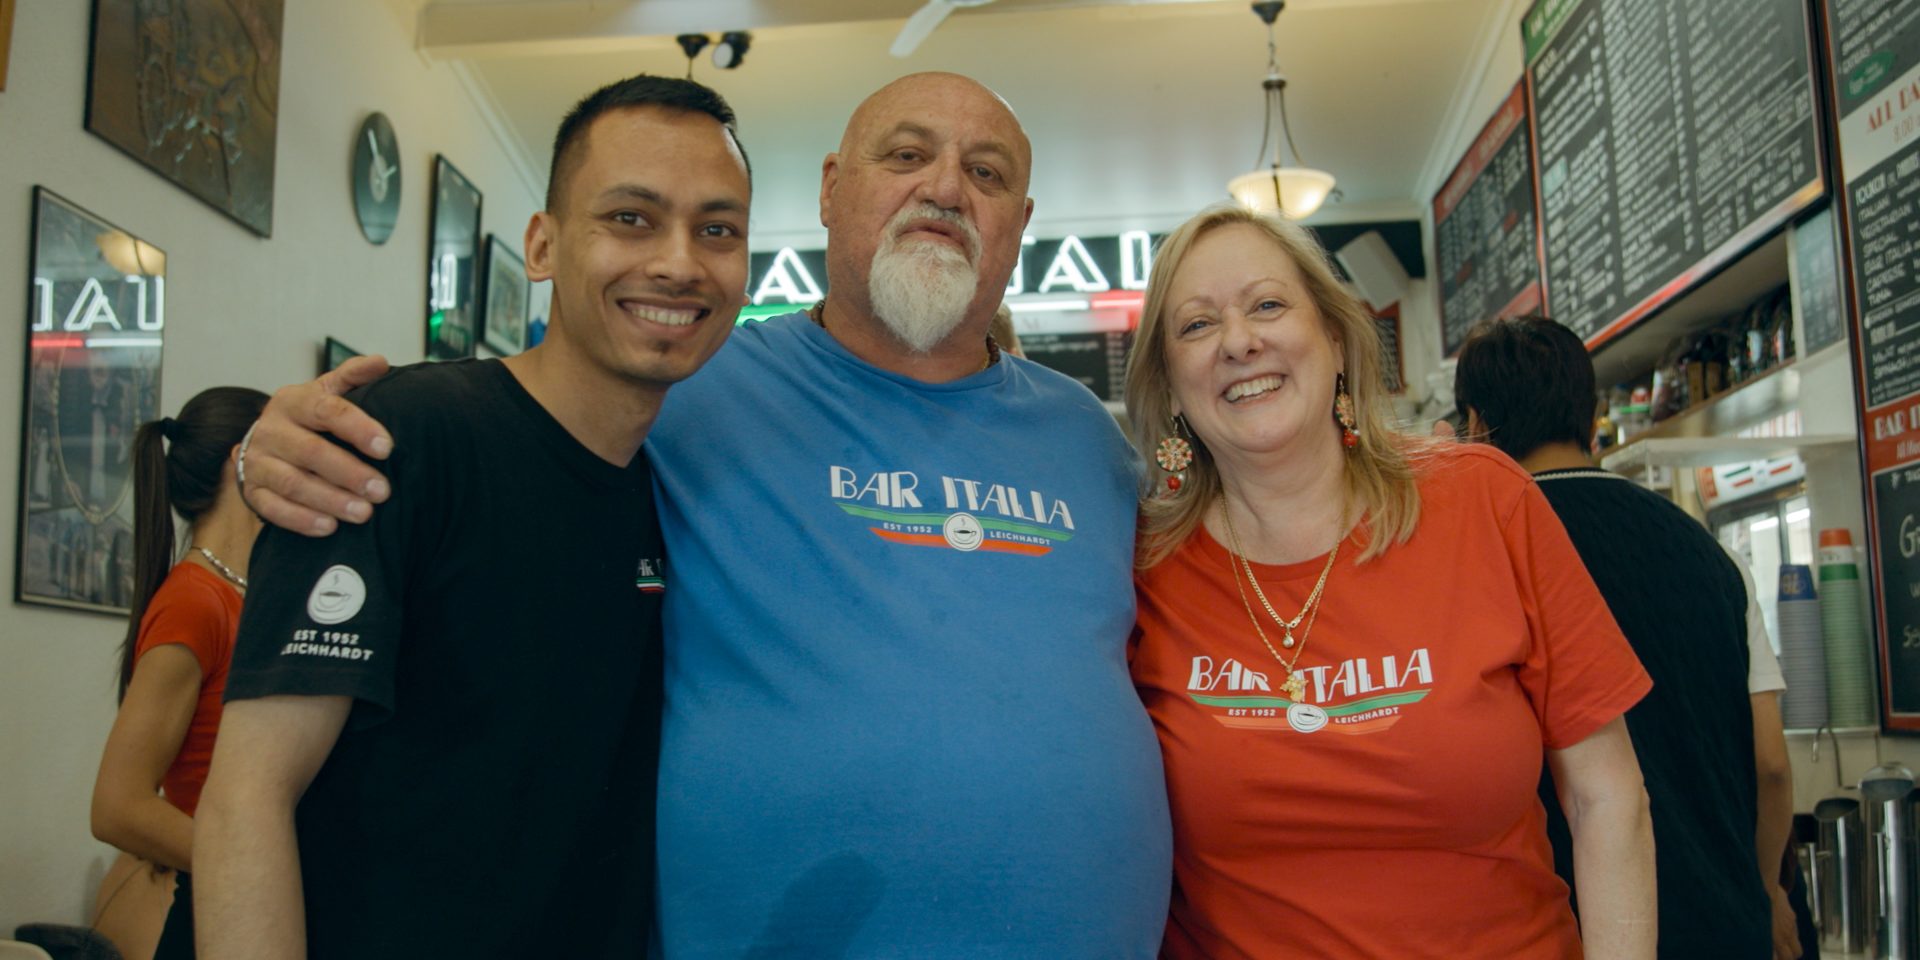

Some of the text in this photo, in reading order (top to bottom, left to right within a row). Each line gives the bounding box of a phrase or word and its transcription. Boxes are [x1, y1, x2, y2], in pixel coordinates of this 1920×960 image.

[1874, 410, 1906, 441] BAR
[830, 465, 1075, 530] BAR ITALIA
[883, 522, 1051, 546] EST 1952 LEICHHARDT
[294, 629, 360, 645] EST 1952
[1187, 655, 1271, 692] BAR
[1228, 706, 1399, 724] EST 1952 LEICHHARDT
